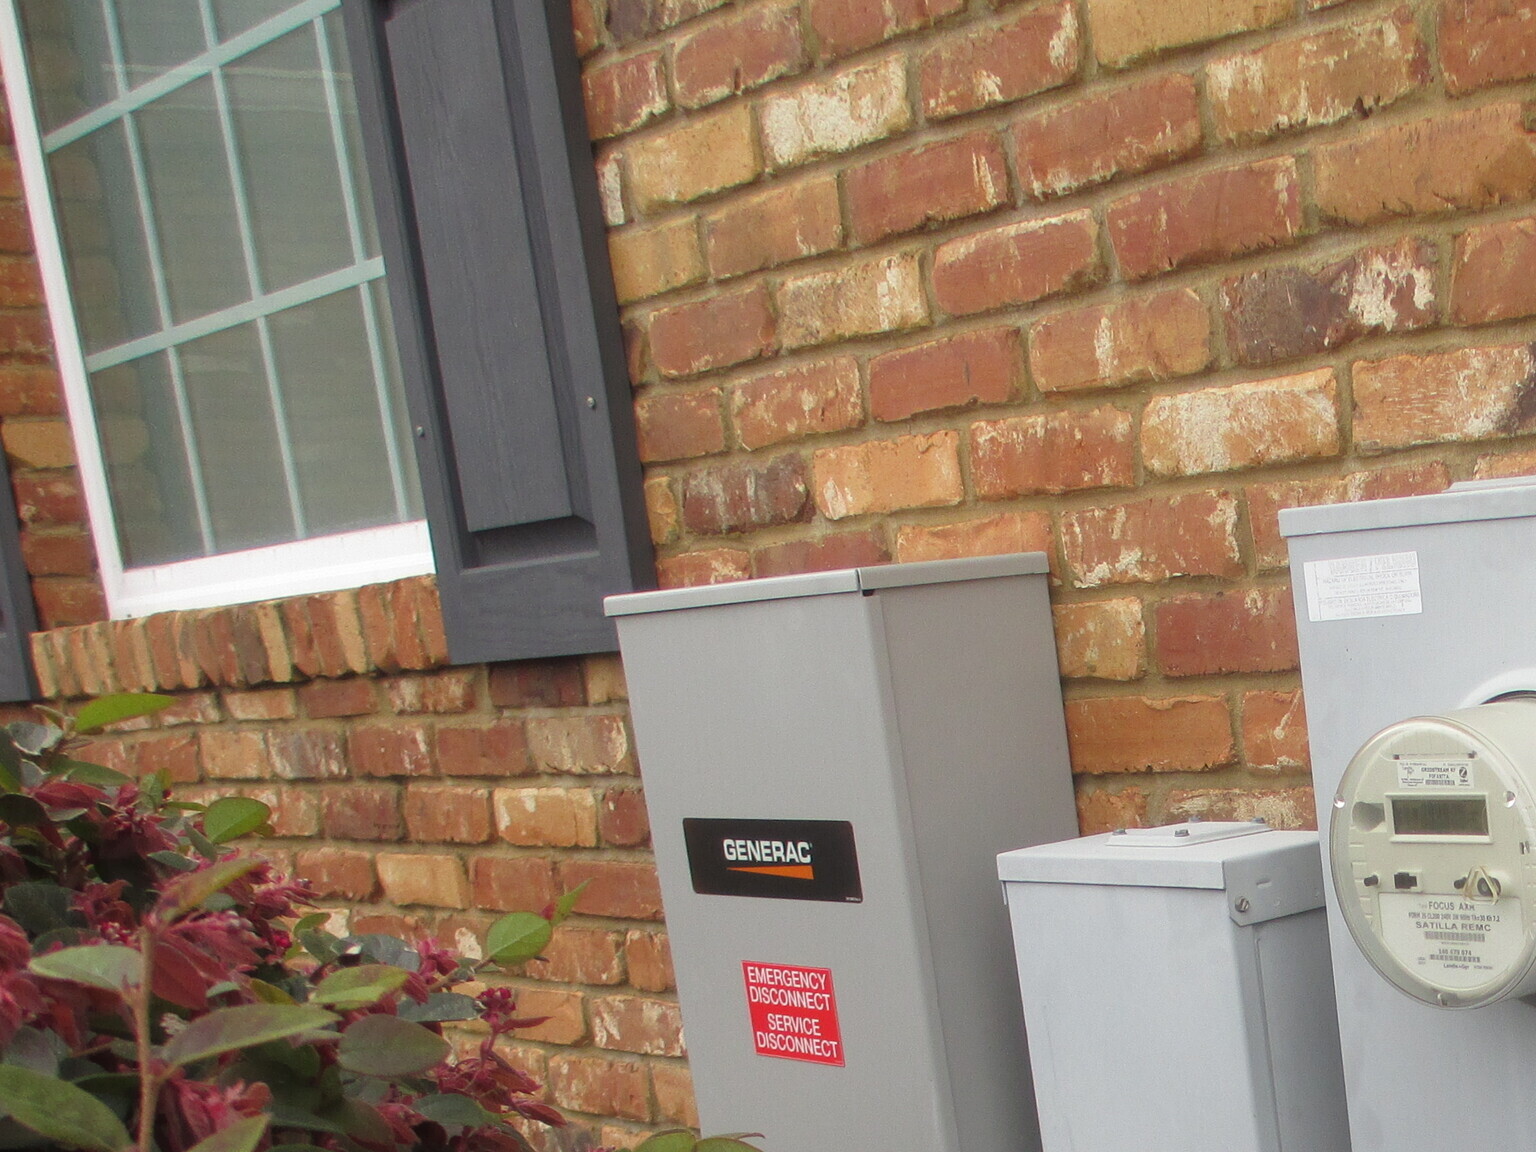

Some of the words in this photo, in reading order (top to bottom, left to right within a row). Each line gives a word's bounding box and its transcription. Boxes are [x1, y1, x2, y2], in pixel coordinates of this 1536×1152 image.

[723, 838, 811, 864] GENERAC
[1428, 901, 1455, 911] FOCUS
[1415, 921, 1457, 930] SATILLA
[1461, 923, 1492, 932] REMC
[747, 966, 826, 990] EMERGENCY
[749, 985, 830, 1011] DISCONNECT
[767, 1013, 821, 1036] SERVICE
[756, 1031, 838, 1058] DISCONNECT
